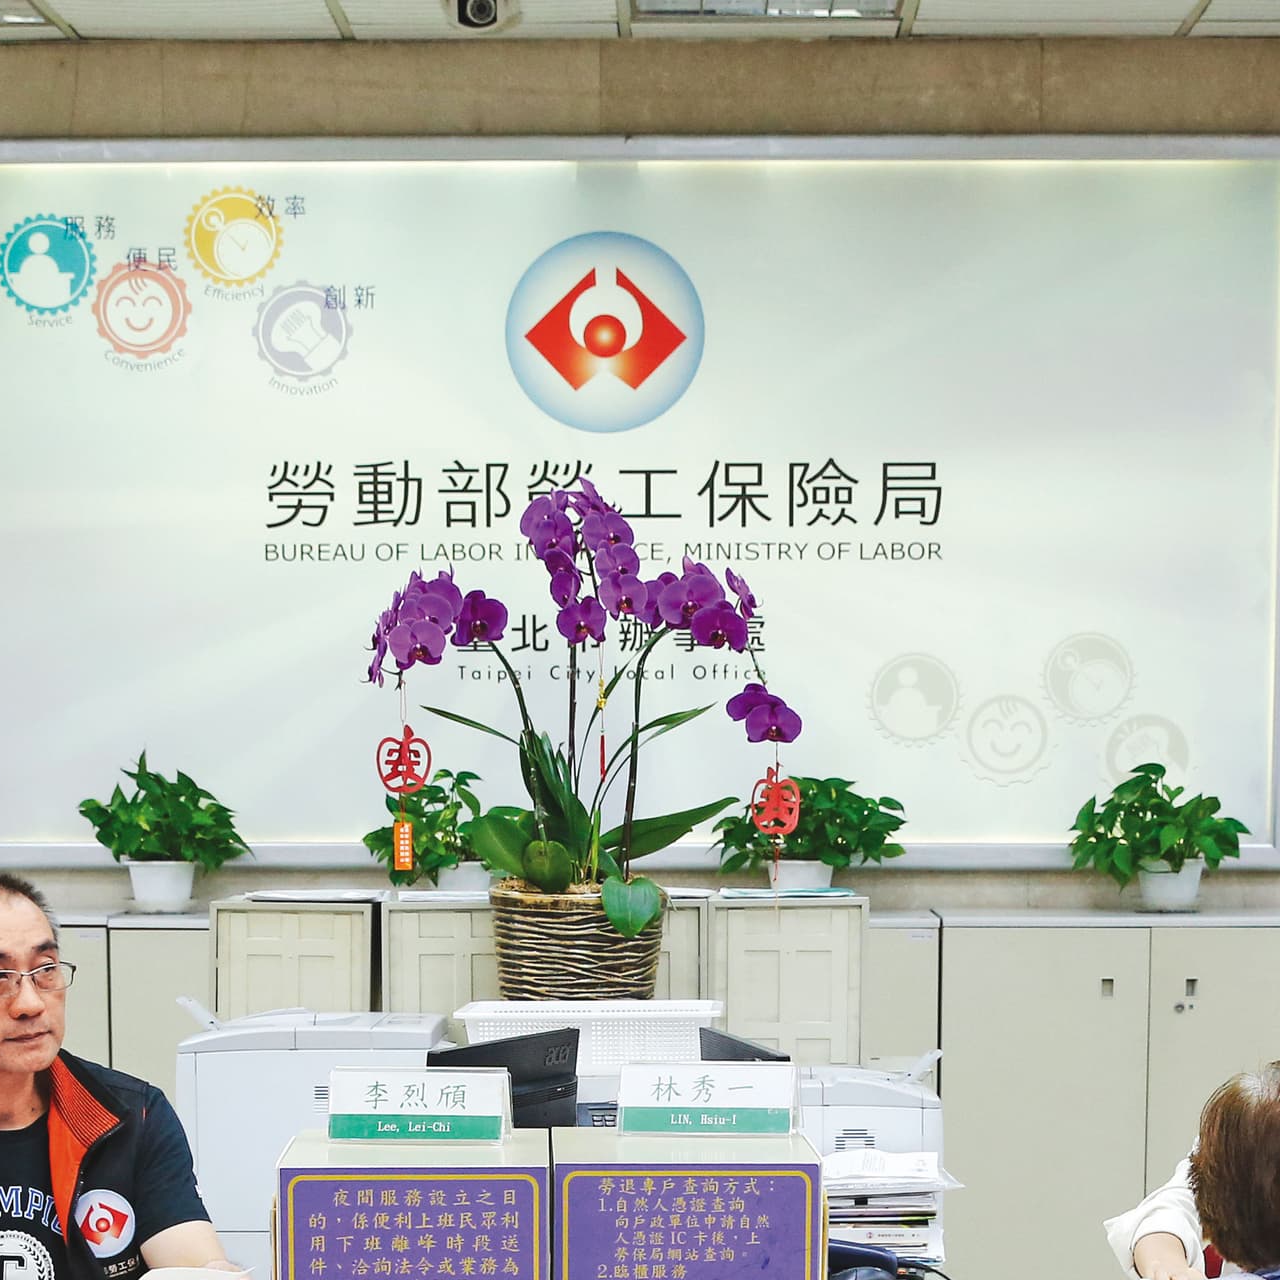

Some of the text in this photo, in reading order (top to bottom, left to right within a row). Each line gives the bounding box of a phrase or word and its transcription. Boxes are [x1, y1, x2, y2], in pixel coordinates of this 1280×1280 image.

[254, 195, 306, 219] 效率
[63, 216, 115, 240] 服務
[126, 247, 178, 272] 便民
[204, 284, 265, 302] Efficiency
[323, 285, 376, 311] 創新
[27, 314, 73, 328] Service
[104, 347, 186, 373] Convenience
[268, 376, 339, 396] Innovation
[264, 543, 366, 561] BUREAU
[375, 543, 409, 561] OF
[421, 543, 504, 561] LABOR
[684, 542, 809, 560] MINISTRY
[826, 542, 852, 560] OF
[860, 542, 943, 560] LABOR
[651, 1074, 754, 1103] 林秀一
[377, 1121, 451, 1133] Lee, Lei-Chi
[670, 1114, 737, 1125] LIN, Hsiu-I
[333, 1189, 517, 1207] 夜間服務設立之目
[614, 1215, 770, 1229] 向戶政單位申請自然
[310, 1235, 520, 1253] 用下班離峰時段送
